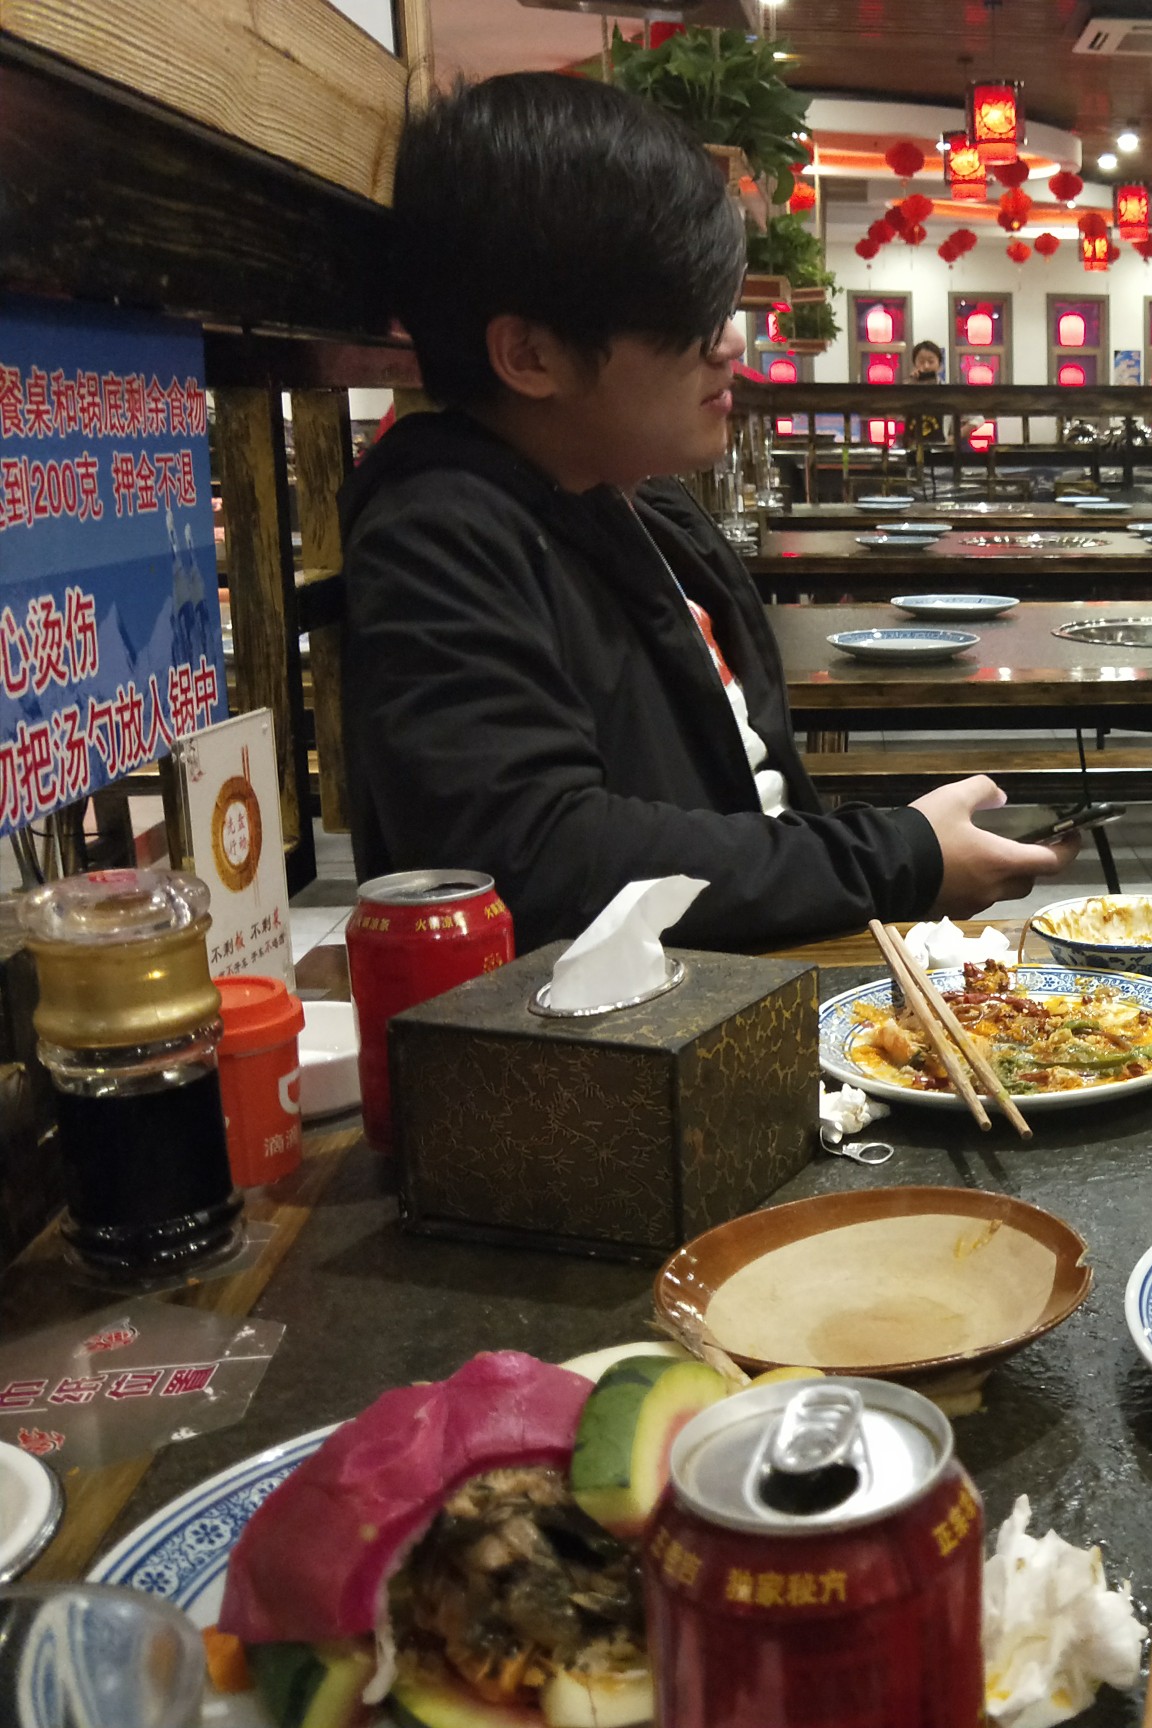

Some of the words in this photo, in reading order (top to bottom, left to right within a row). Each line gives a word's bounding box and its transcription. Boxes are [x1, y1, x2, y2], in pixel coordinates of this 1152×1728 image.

[0, 364, 206, 438] 餐桌和锅底剩余食物
[0, 451, 103, 530] 到200克
[111, 450, 196, 517] 押金不退
